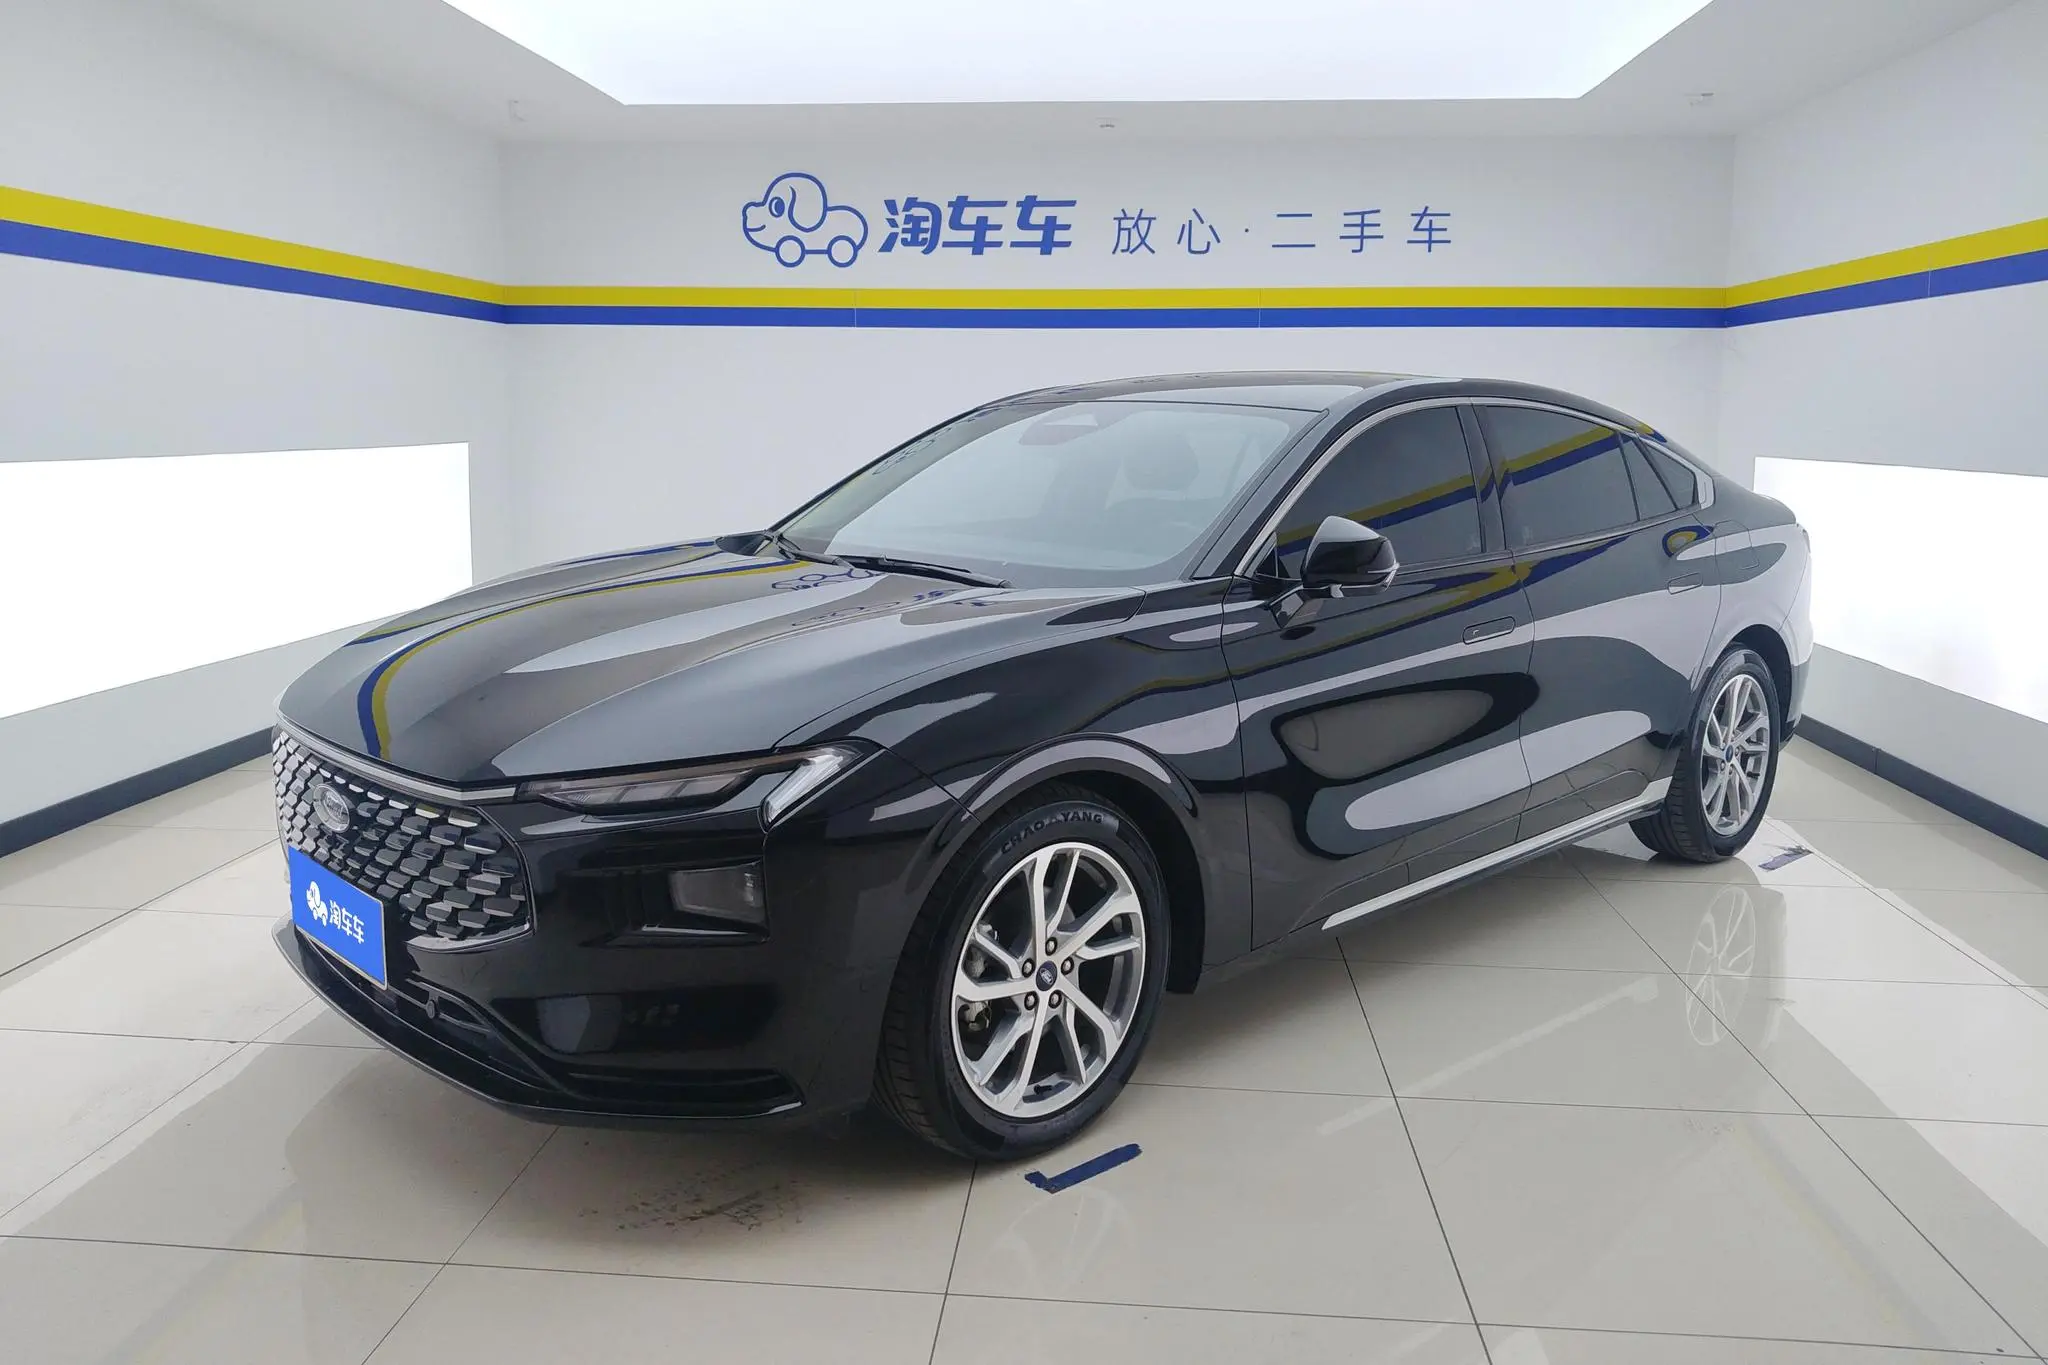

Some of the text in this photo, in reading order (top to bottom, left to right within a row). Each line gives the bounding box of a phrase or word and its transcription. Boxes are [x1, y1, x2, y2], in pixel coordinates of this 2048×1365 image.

[879, 193, 1078, 256] 淘车车
[329, 899, 365, 944] 淘车车
